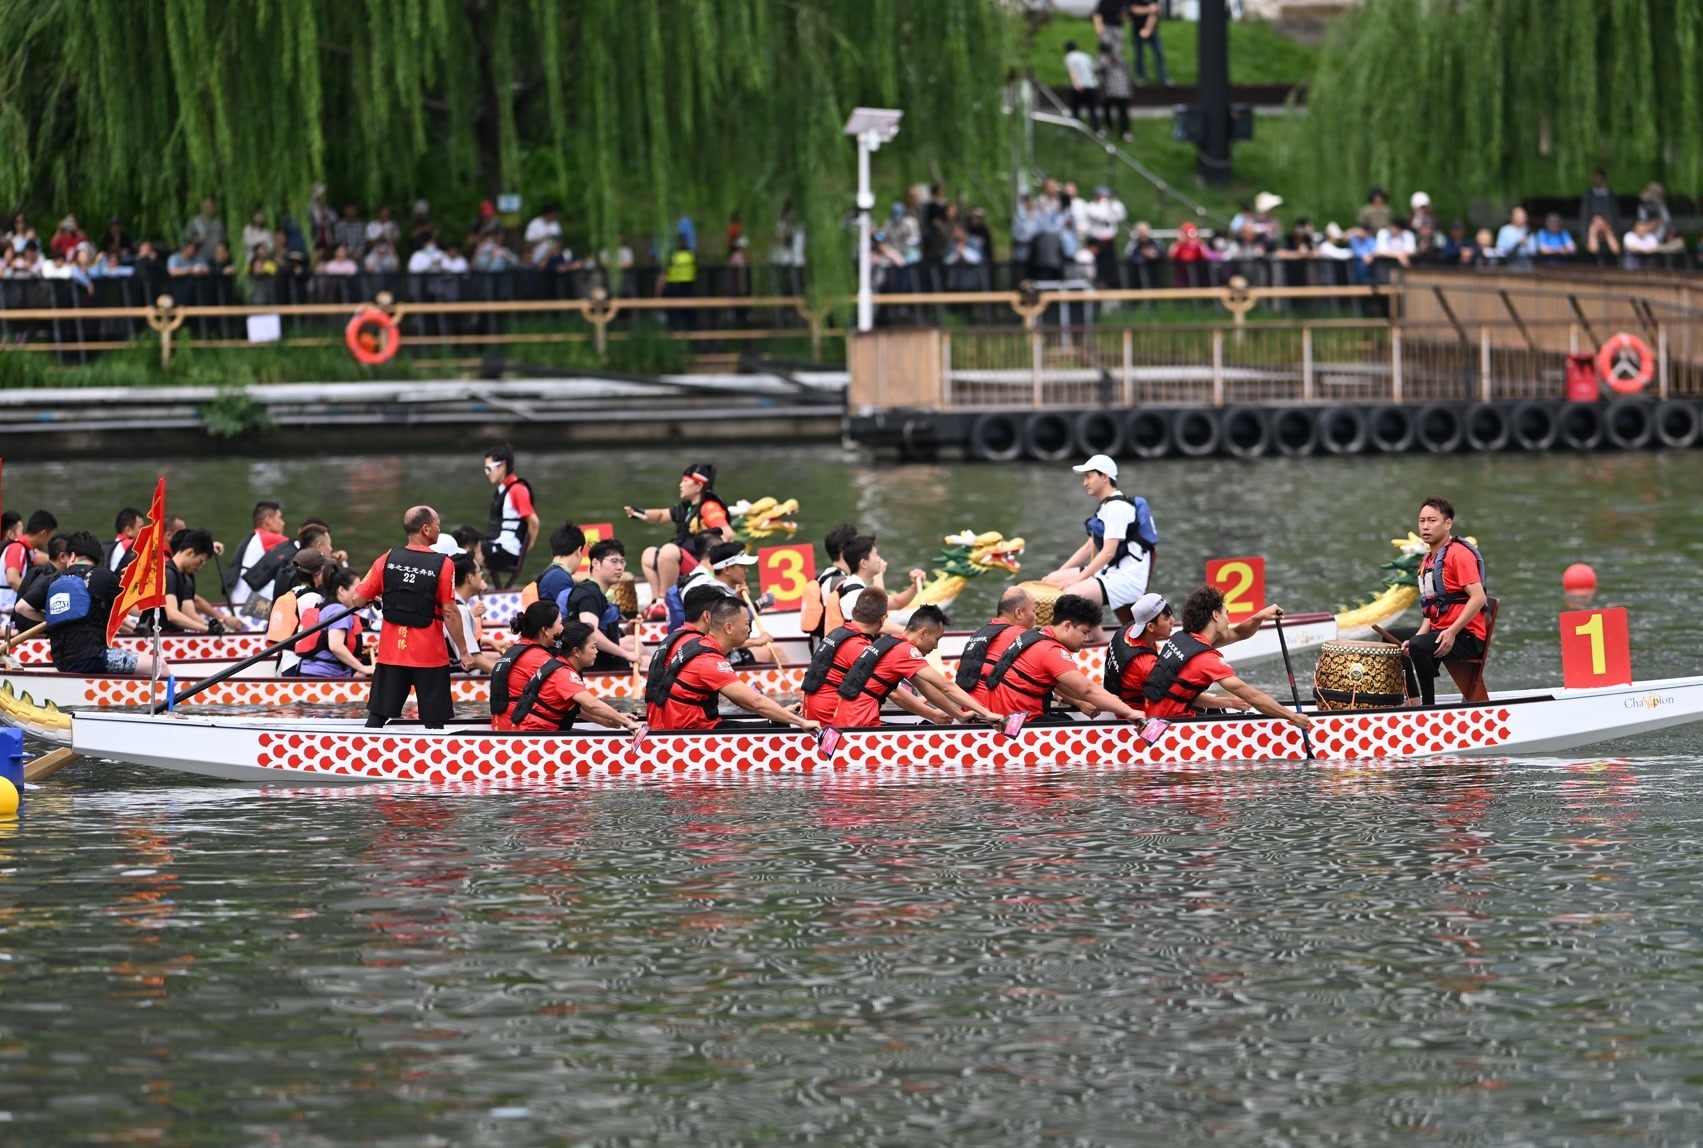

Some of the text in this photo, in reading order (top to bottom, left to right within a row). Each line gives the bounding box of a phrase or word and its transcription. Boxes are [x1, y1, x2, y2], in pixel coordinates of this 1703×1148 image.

[402, 573, 416, 584] 22
[768, 549, 807, 601] 3
[1216, 562, 1254, 613] 2
[1575, 613, 1607, 675] 1
